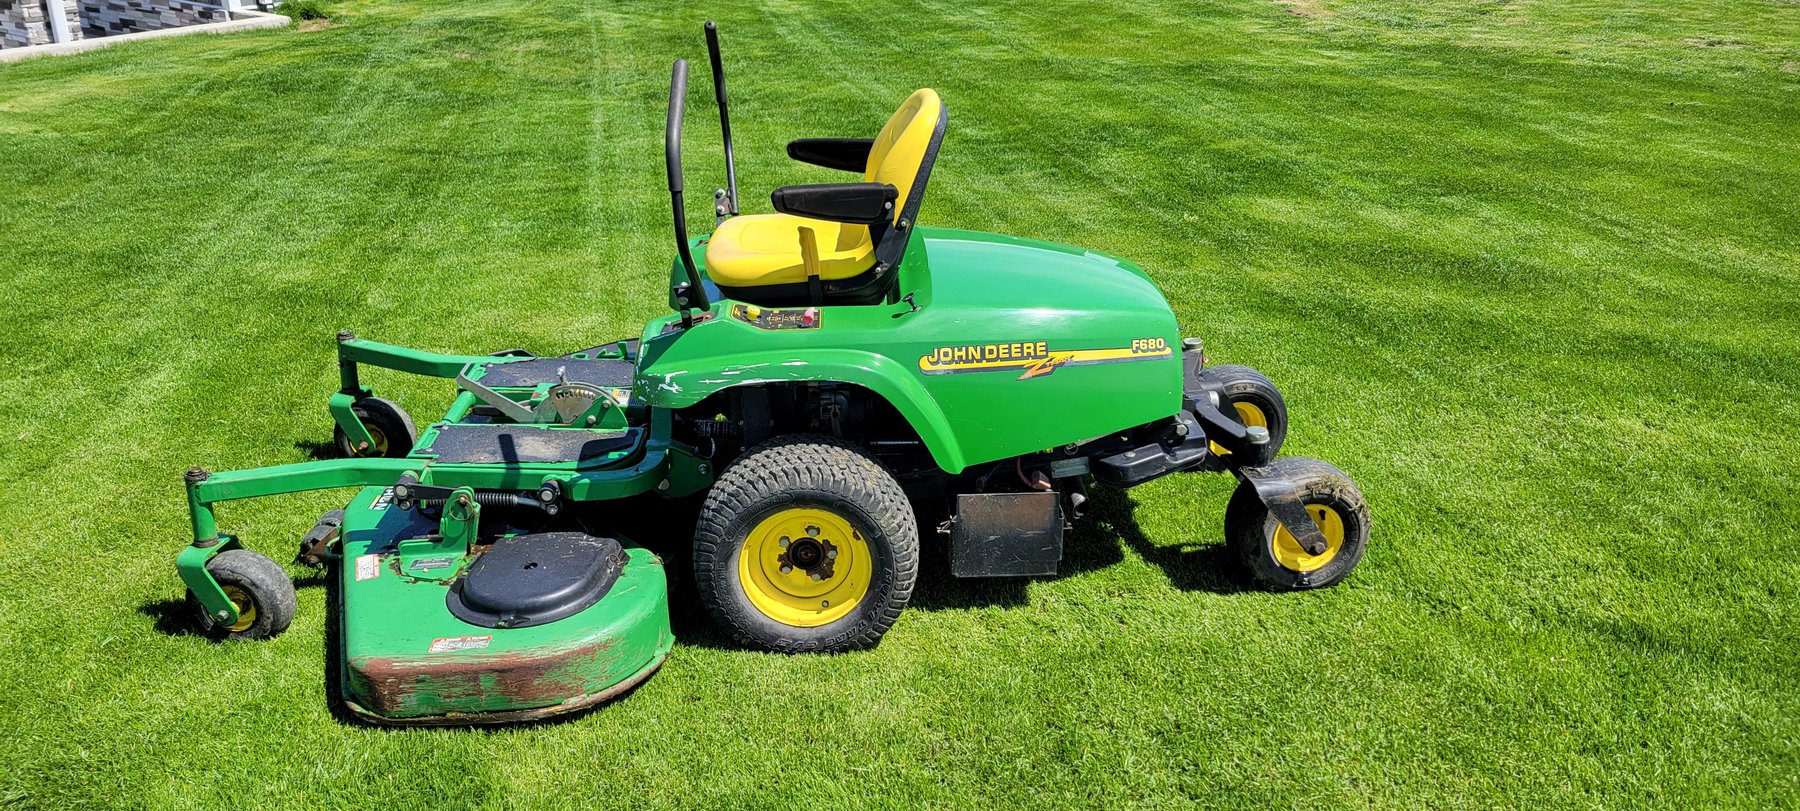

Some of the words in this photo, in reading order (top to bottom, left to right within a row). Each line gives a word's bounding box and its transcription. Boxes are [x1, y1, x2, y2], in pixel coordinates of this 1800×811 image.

[928, 345, 981, 362] JOHN
[985, 341, 1048, 359] DEERE
[1132, 337, 1165, 351] F680
